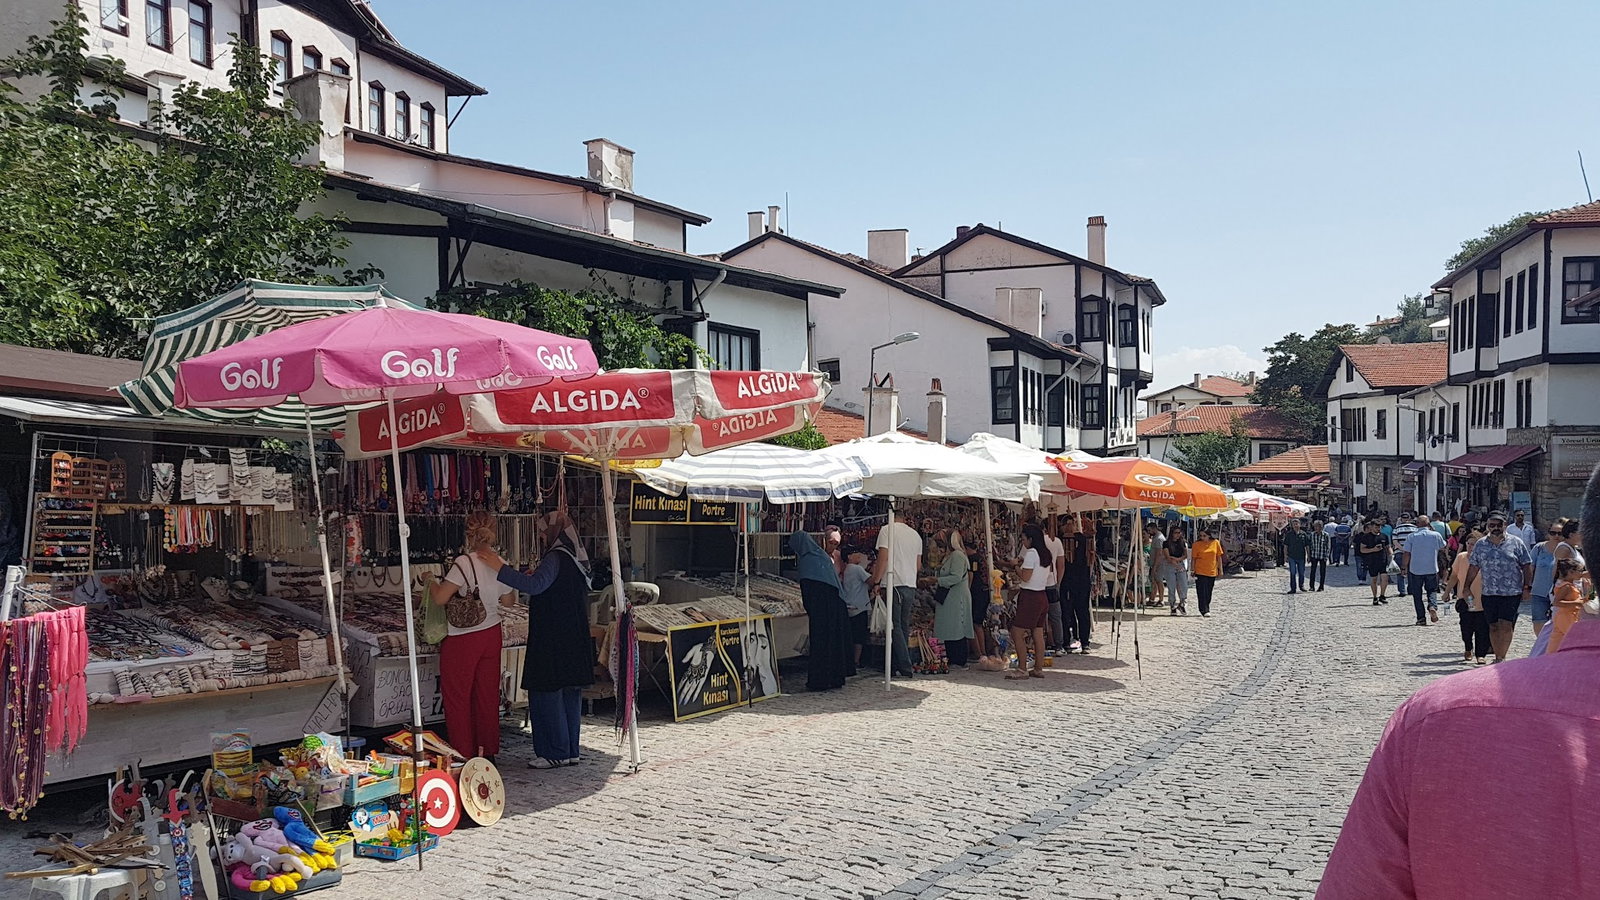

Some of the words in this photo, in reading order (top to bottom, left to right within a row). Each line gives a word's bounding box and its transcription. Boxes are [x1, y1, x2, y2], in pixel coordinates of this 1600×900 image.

[380, 347, 460, 379] Golf
[537, 345, 578, 371] Golf
[219, 357, 284, 391] Golf
[634, 494, 657, 510] Hint
[658, 496, 687, 511] Kınası
[702, 503, 726, 516] Portre
[721, 635, 740, 646] Portre
[711, 672, 729, 688] Hint
[703, 689, 729, 706] Kınası
